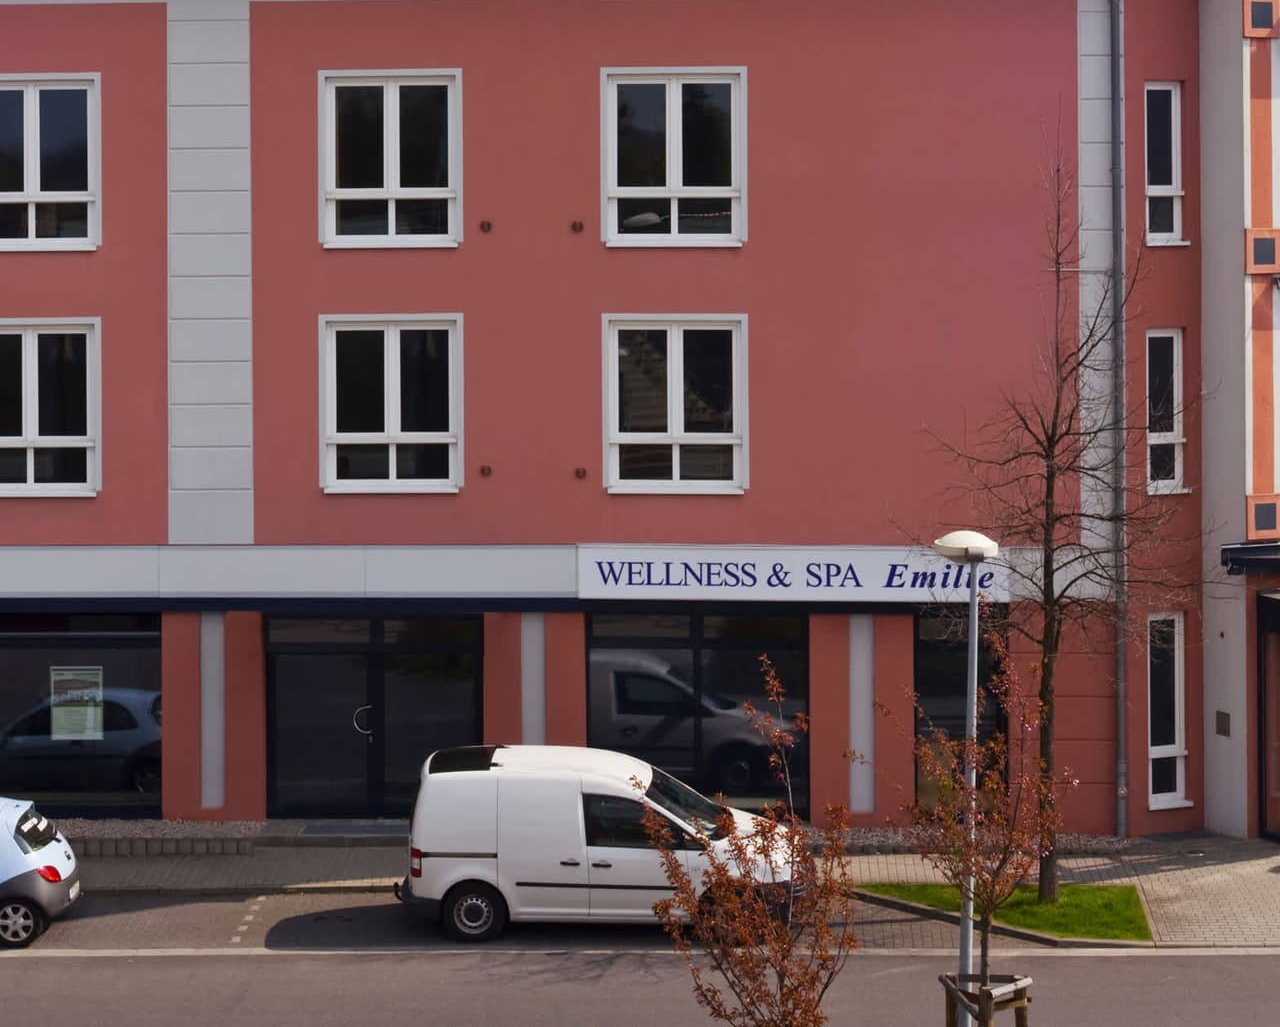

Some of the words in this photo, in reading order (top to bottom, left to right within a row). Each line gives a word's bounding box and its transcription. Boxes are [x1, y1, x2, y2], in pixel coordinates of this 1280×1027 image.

[596, 560, 757, 588] WELLNESS
[766, 562, 793, 588] &
[805, 562, 864, 588] SPA
